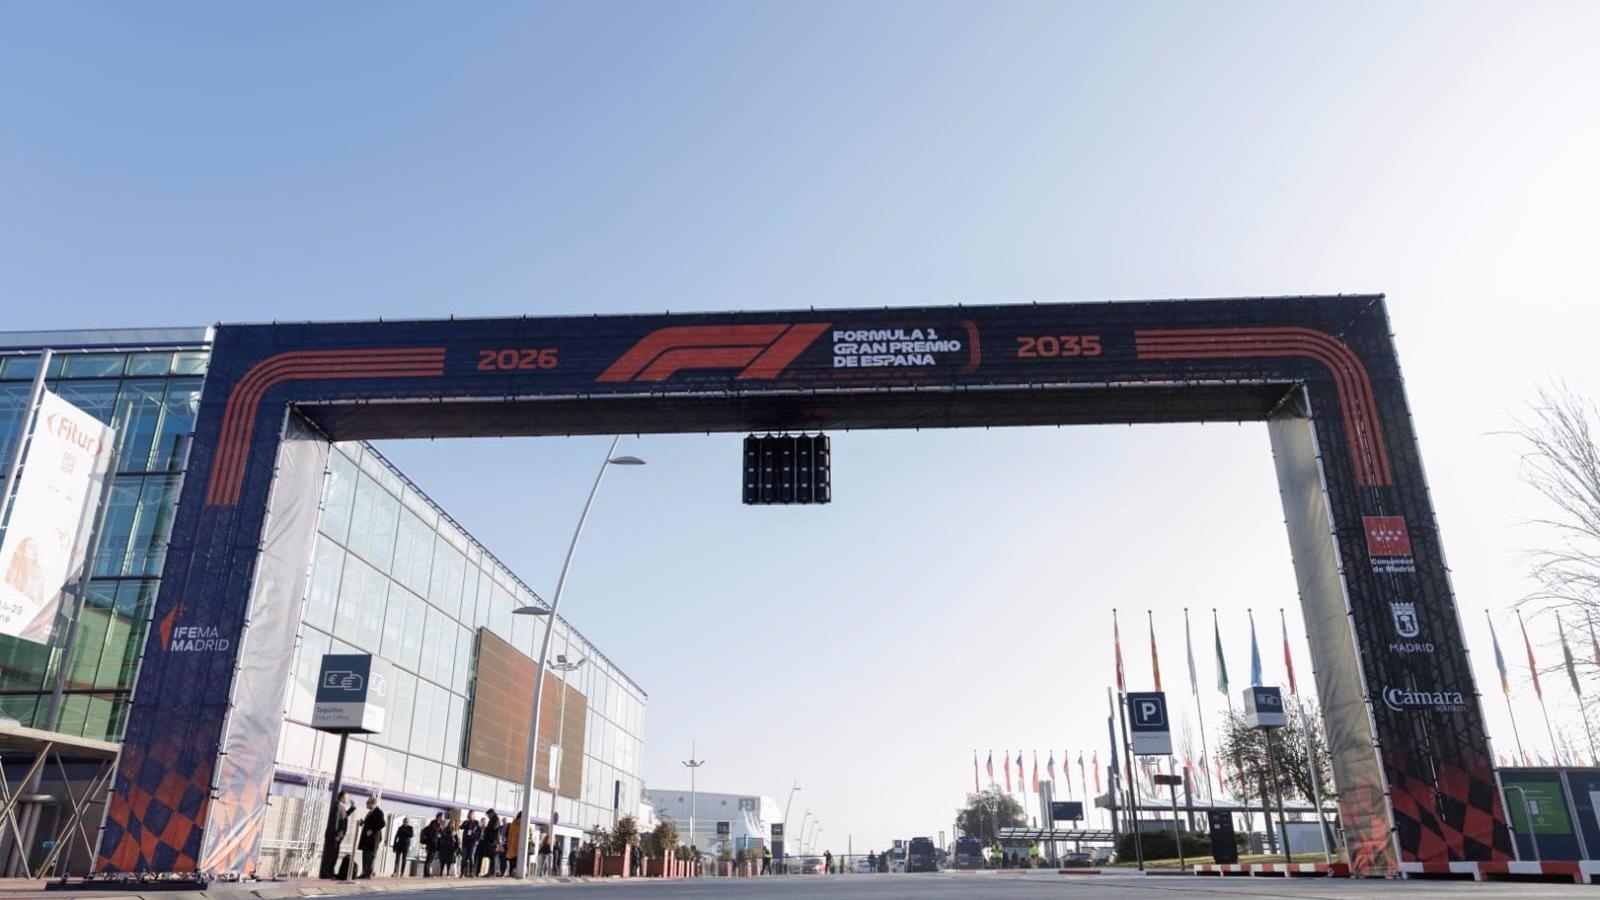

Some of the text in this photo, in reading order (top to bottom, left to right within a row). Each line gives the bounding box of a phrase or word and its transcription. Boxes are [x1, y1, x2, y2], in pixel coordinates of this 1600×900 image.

[832, 327, 939, 343] FORMULA 1
[832, 340, 961, 356] GRAN PREMIO
[1016, 334, 1102, 358] 2035
[477, 347, 558, 371] 2026
[833, 355, 859, 368] DE
[57, 416, 96, 453] Fitur
[1371, 557, 1414, 565] Comunidad
[1373, 565, 1416, 573] de Madrid
[173, 625, 219, 639] IFEMA
[170, 638, 230, 652] MADRID
[1389, 644, 1434, 653] MADRID
[1389, 688, 1464, 705] Cámara
[1141, 702, 1157, 722] P
